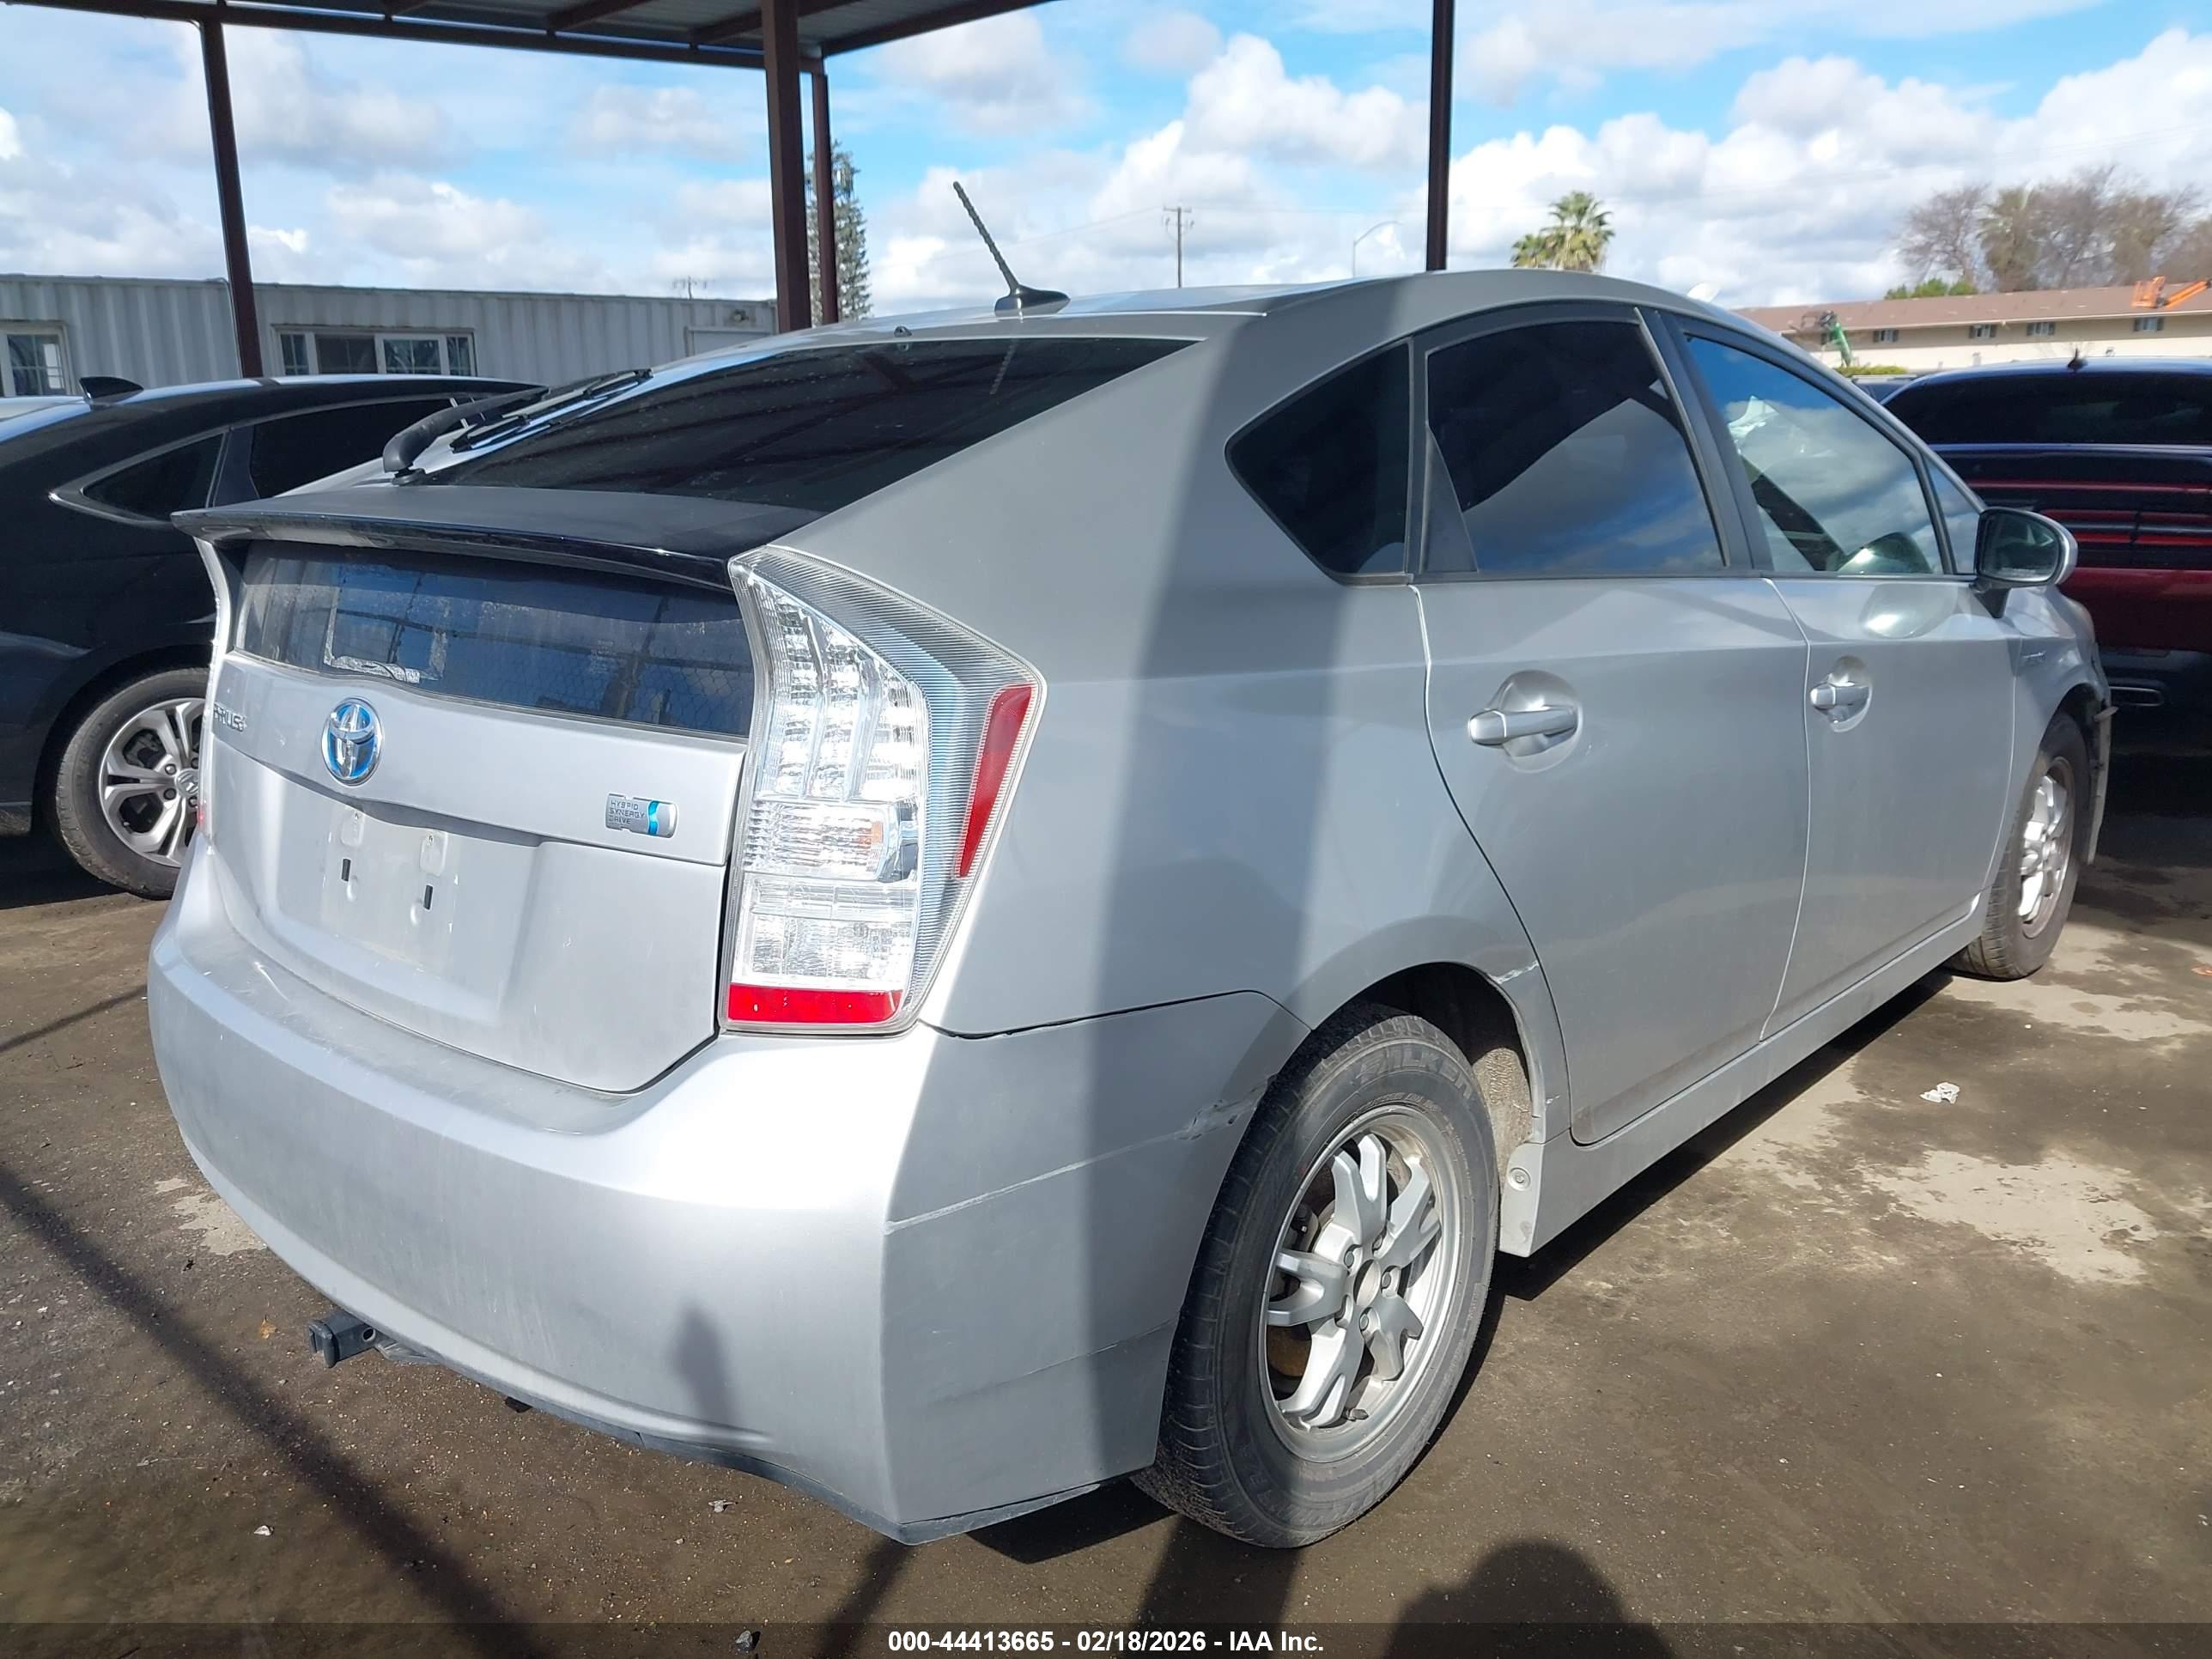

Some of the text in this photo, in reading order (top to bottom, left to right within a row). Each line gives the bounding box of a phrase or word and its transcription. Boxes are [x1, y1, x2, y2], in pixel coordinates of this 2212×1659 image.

[610, 799, 640, 811] HYBRID
[609, 807, 646, 818] SYNERGY
[608, 814, 632, 825] DRIVE
